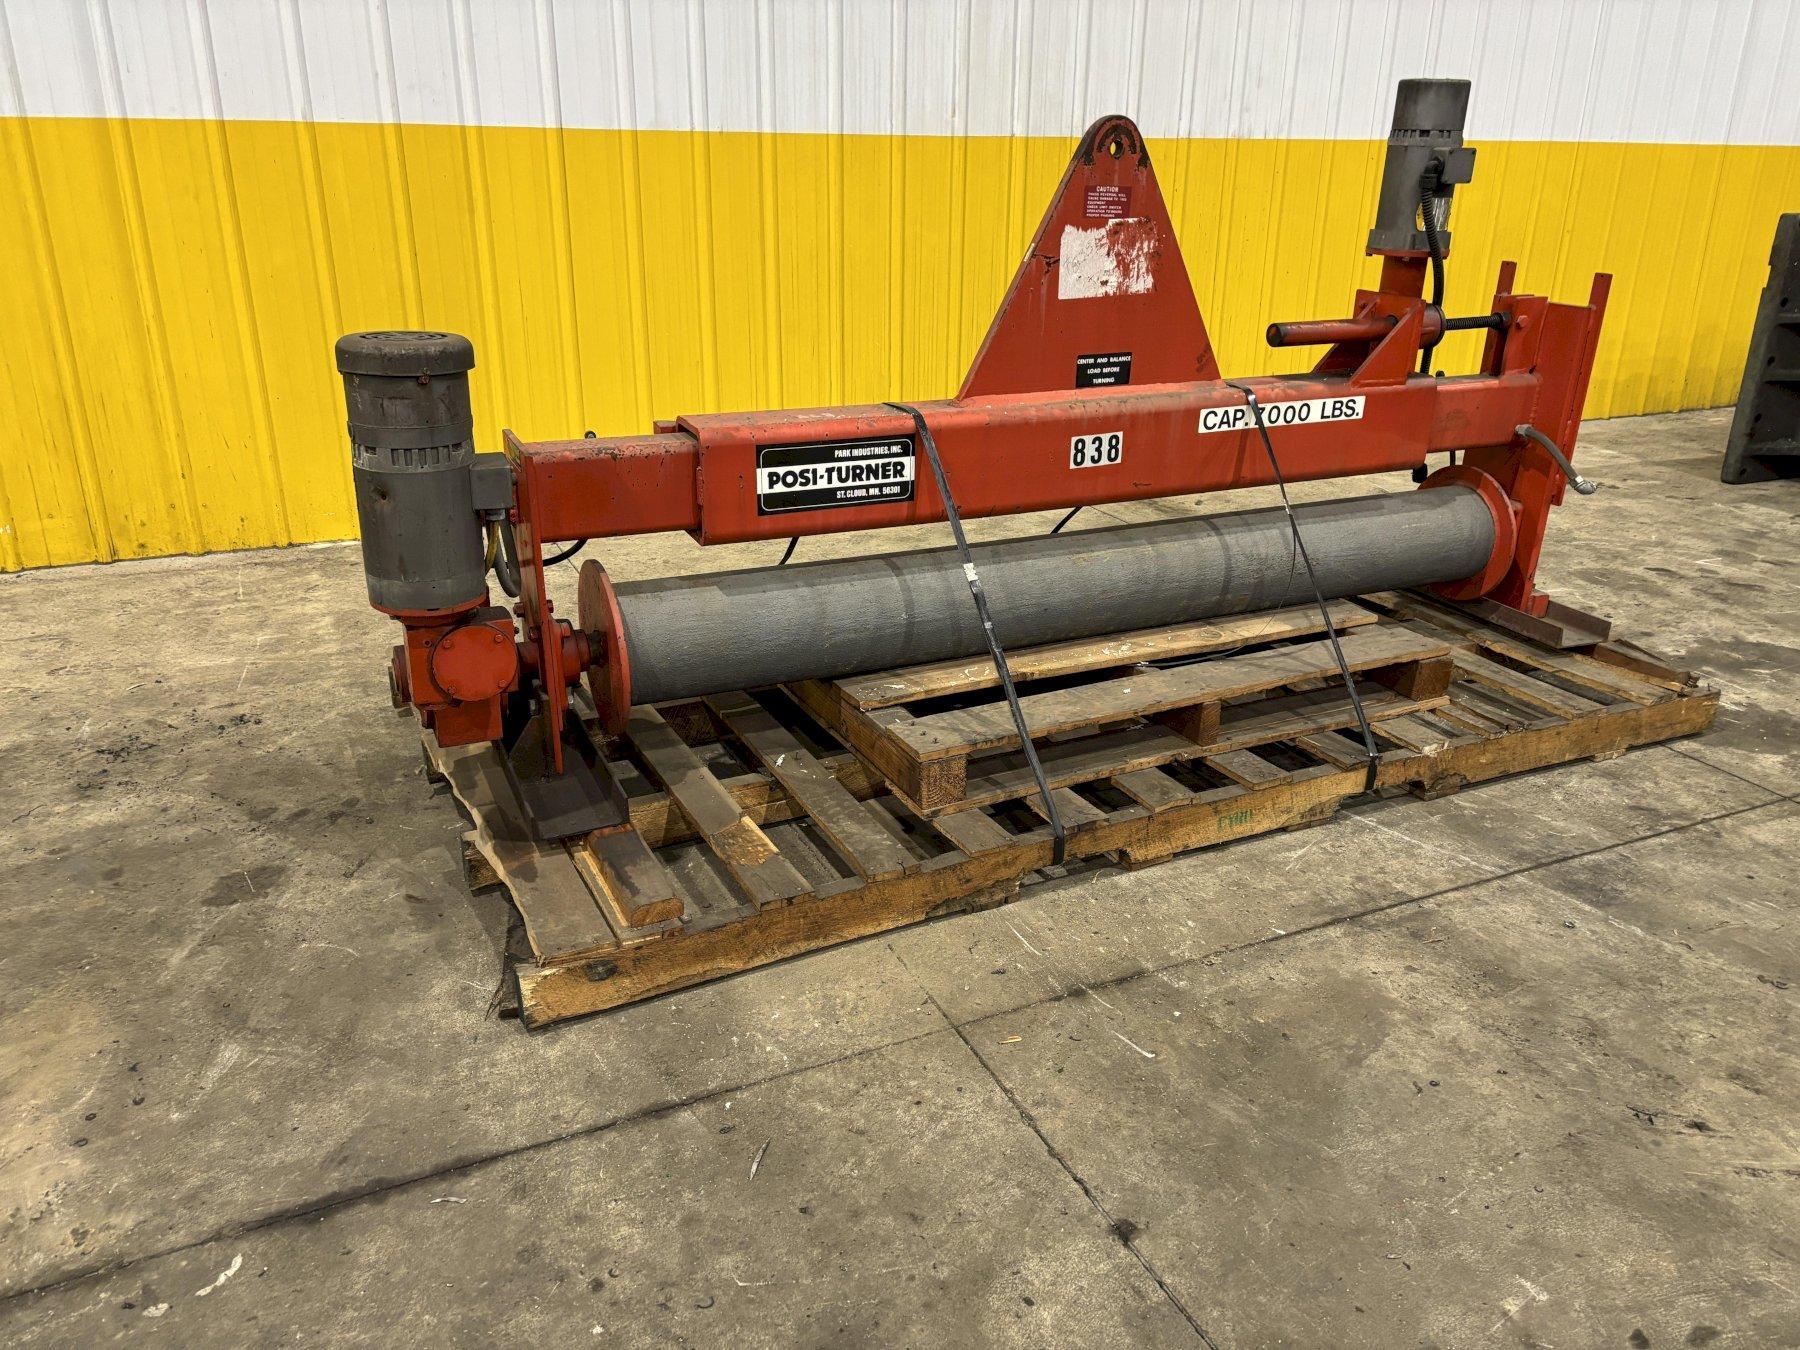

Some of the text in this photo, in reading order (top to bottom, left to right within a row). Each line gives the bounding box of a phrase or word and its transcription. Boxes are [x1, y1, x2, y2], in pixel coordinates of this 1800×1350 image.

[1203, 409, 1249, 430] CAP.
[1320, 399, 1360, 420] LBS.
[834, 449, 851, 458] PARK
[890, 445, 904, 454] INC.
[1073, 434, 1120, 466] 838
[767, 460, 906, 490] POSI-TURNER
[836, 490, 846, 499] ST.
[882, 486, 901, 495] 56301
